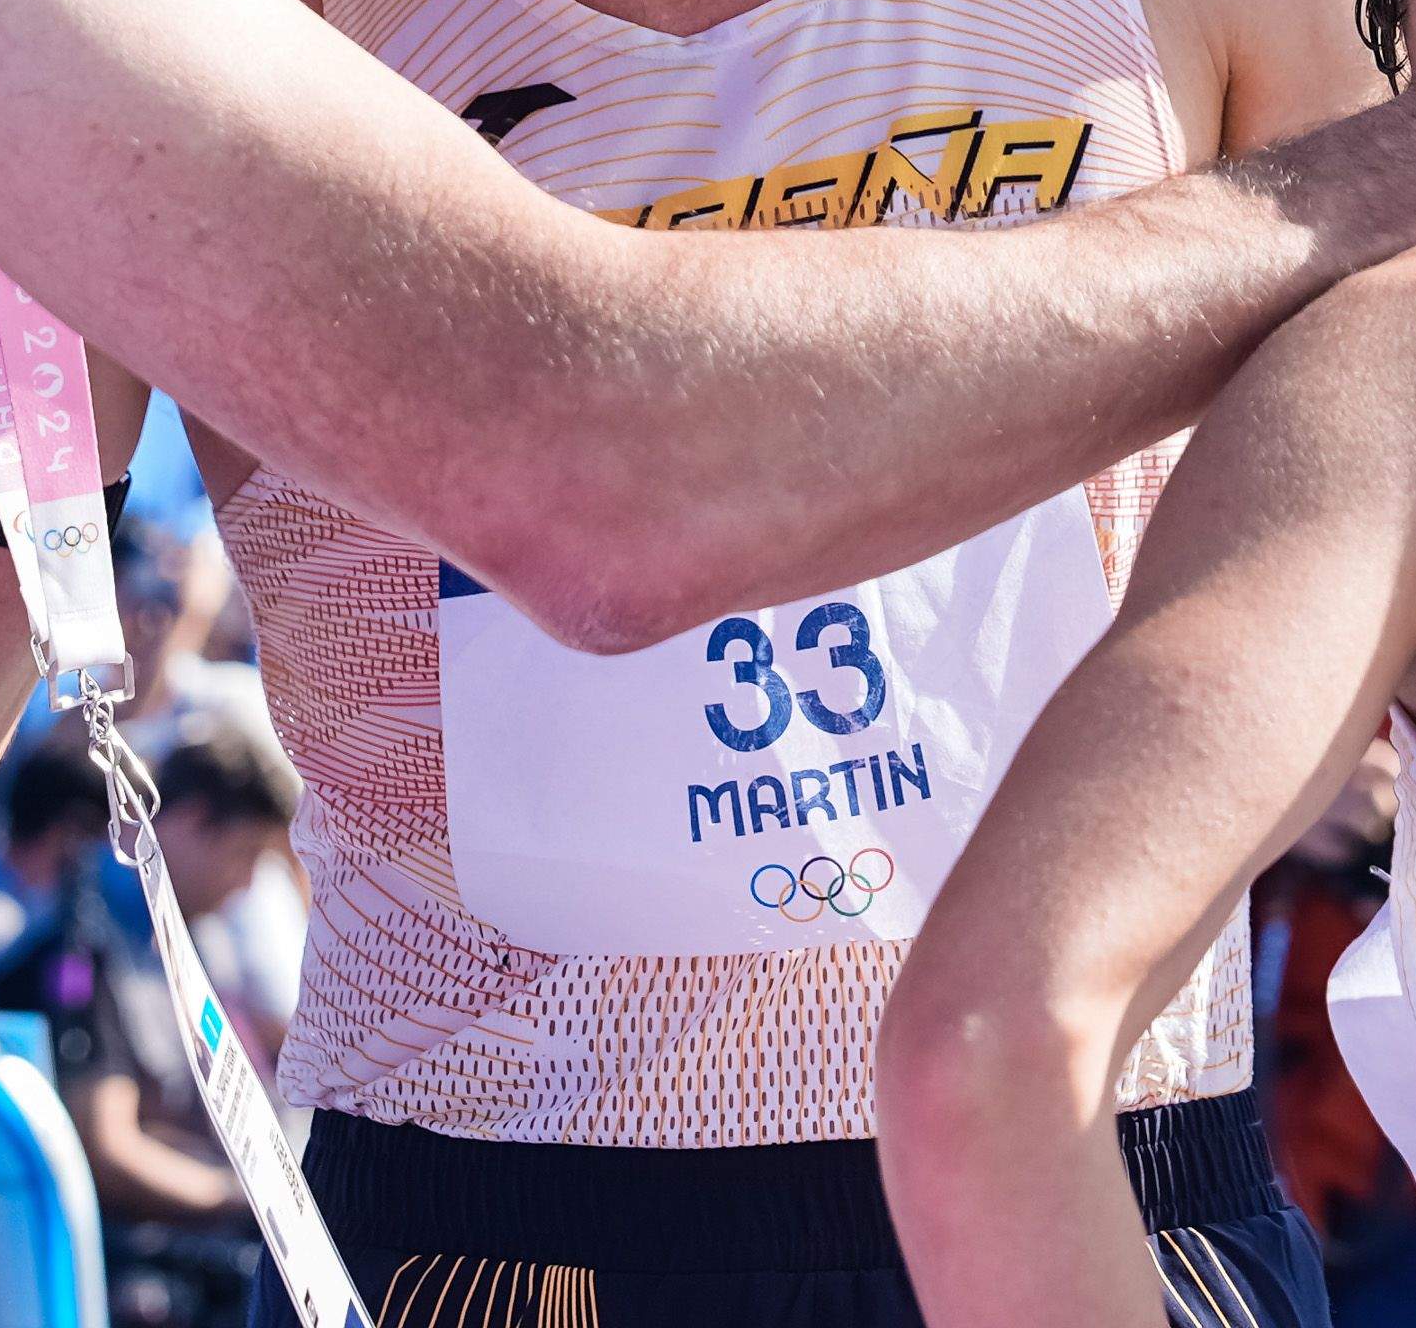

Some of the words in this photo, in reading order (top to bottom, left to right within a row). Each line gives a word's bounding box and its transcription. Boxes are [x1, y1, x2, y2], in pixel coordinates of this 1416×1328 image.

[22, 325, 74, 473] 2024
[704, 602, 887, 753] 33
[687, 743, 932, 843] MARTIN
